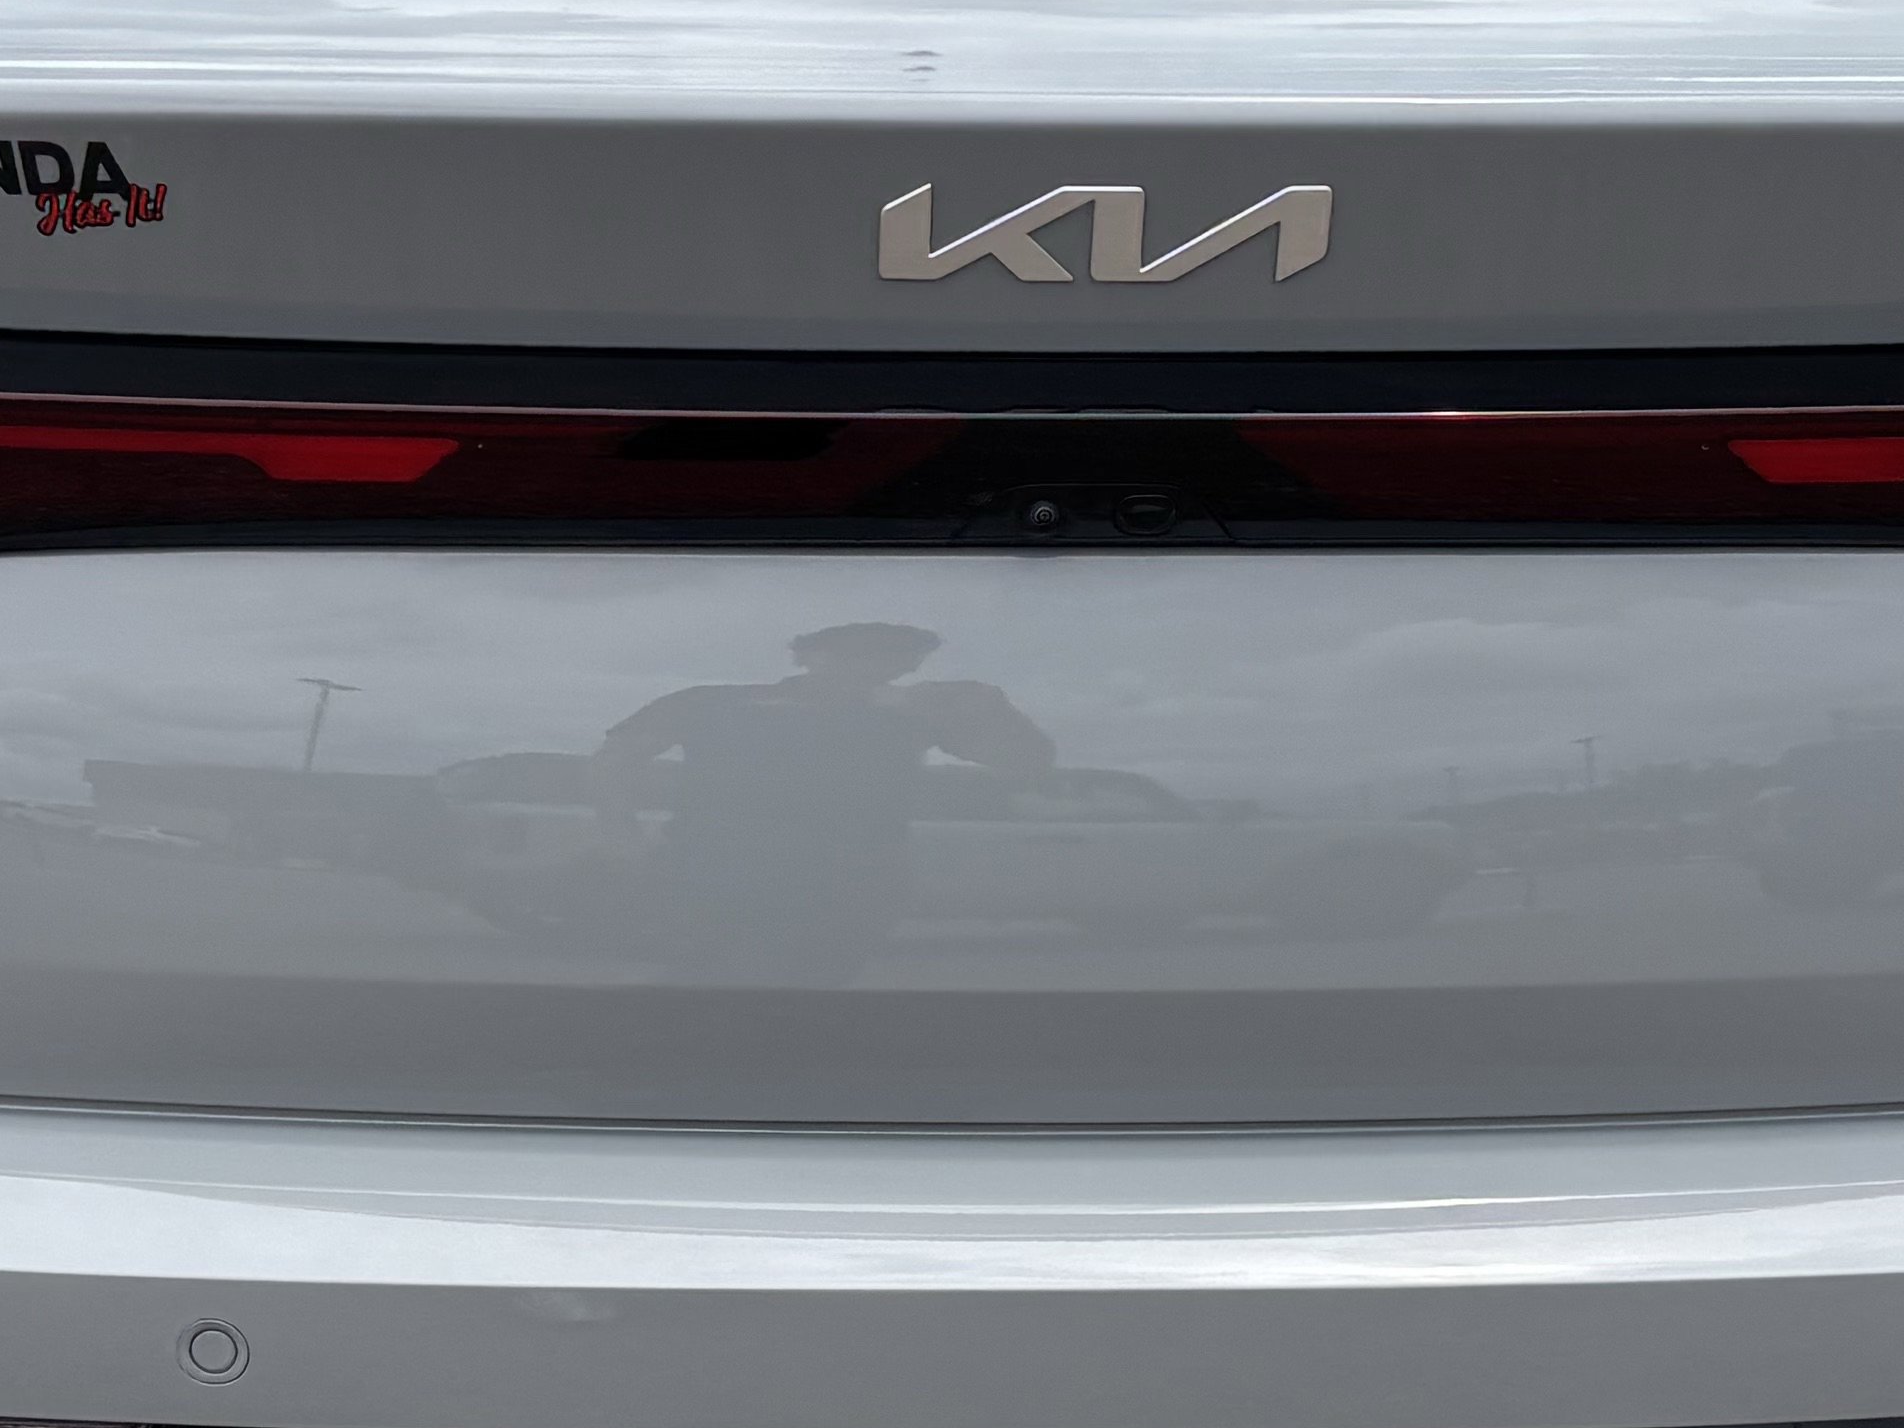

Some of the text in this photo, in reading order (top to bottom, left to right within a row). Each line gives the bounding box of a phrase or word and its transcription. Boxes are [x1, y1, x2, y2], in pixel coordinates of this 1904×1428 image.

[35, 183, 168, 236] Has It!
[879, 183, 1332, 282] KIA
